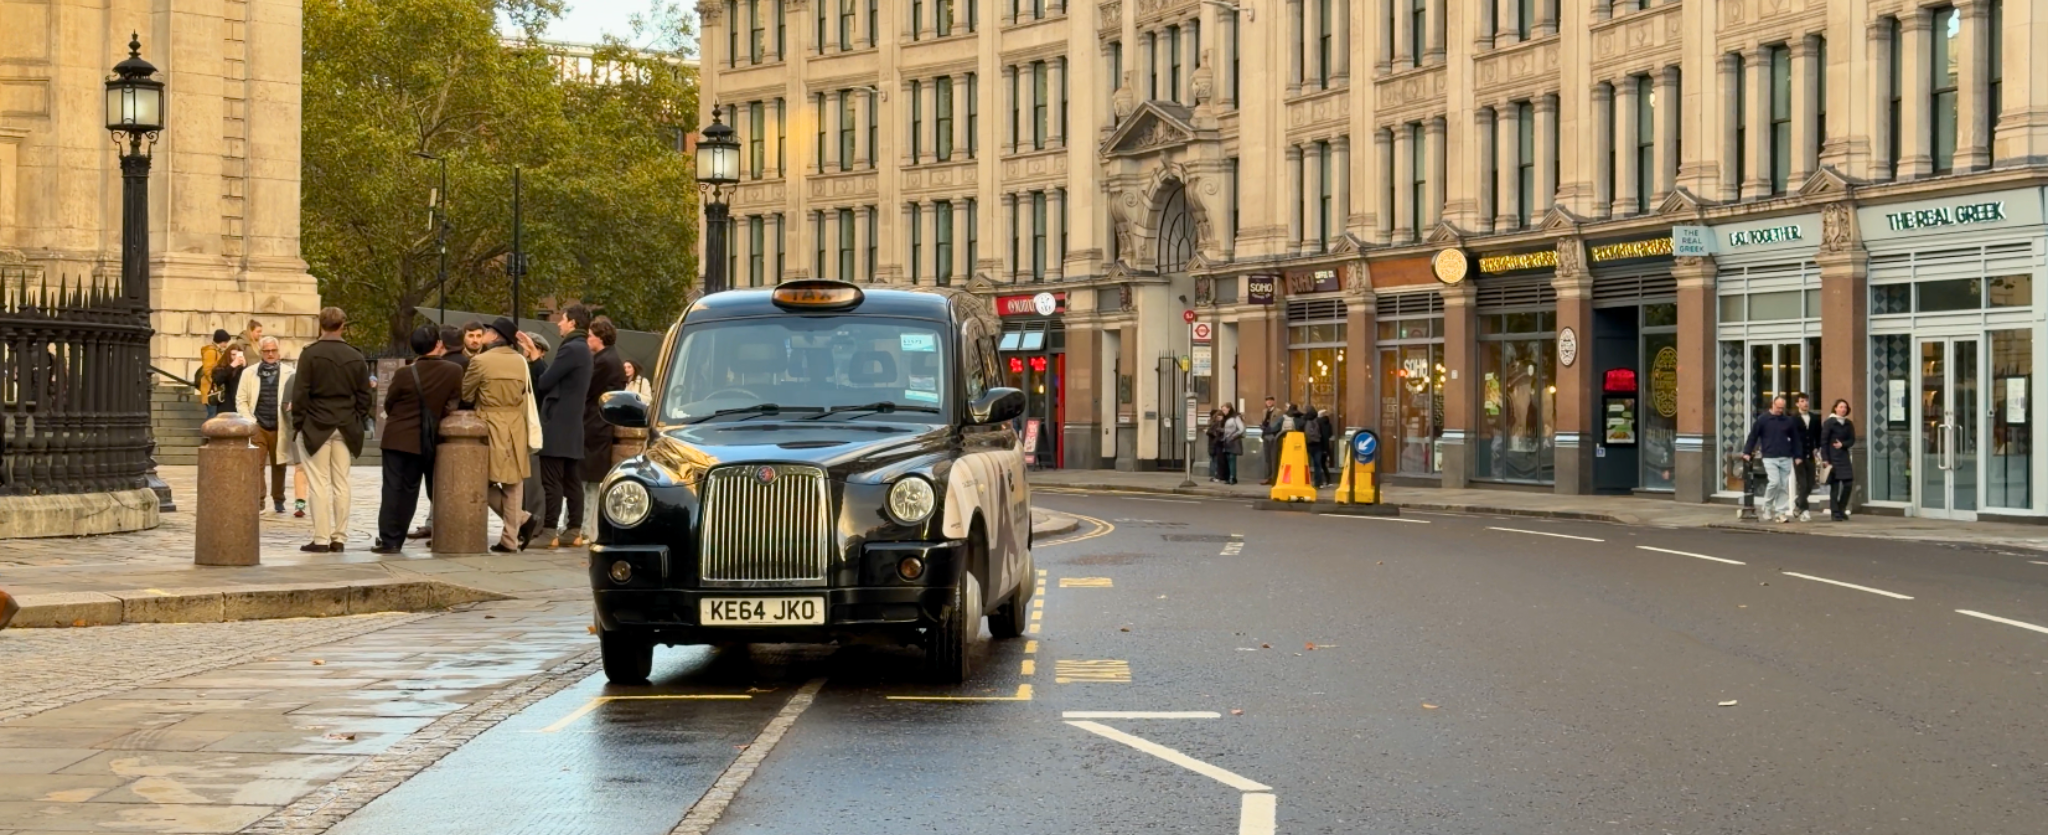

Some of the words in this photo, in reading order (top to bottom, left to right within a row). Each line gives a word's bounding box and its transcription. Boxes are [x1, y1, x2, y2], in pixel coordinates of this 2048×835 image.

[1886, 210, 1916, 230] THE
[1916, 207, 1955, 227] REAL
[1955, 201, 2006, 223] GREEK
[1250, 283, 1273, 292] SOHO
[1404, 359, 1428, 378] SOHO
[711, 600, 766, 620] KE64
[773, 600, 815, 620] JKO
